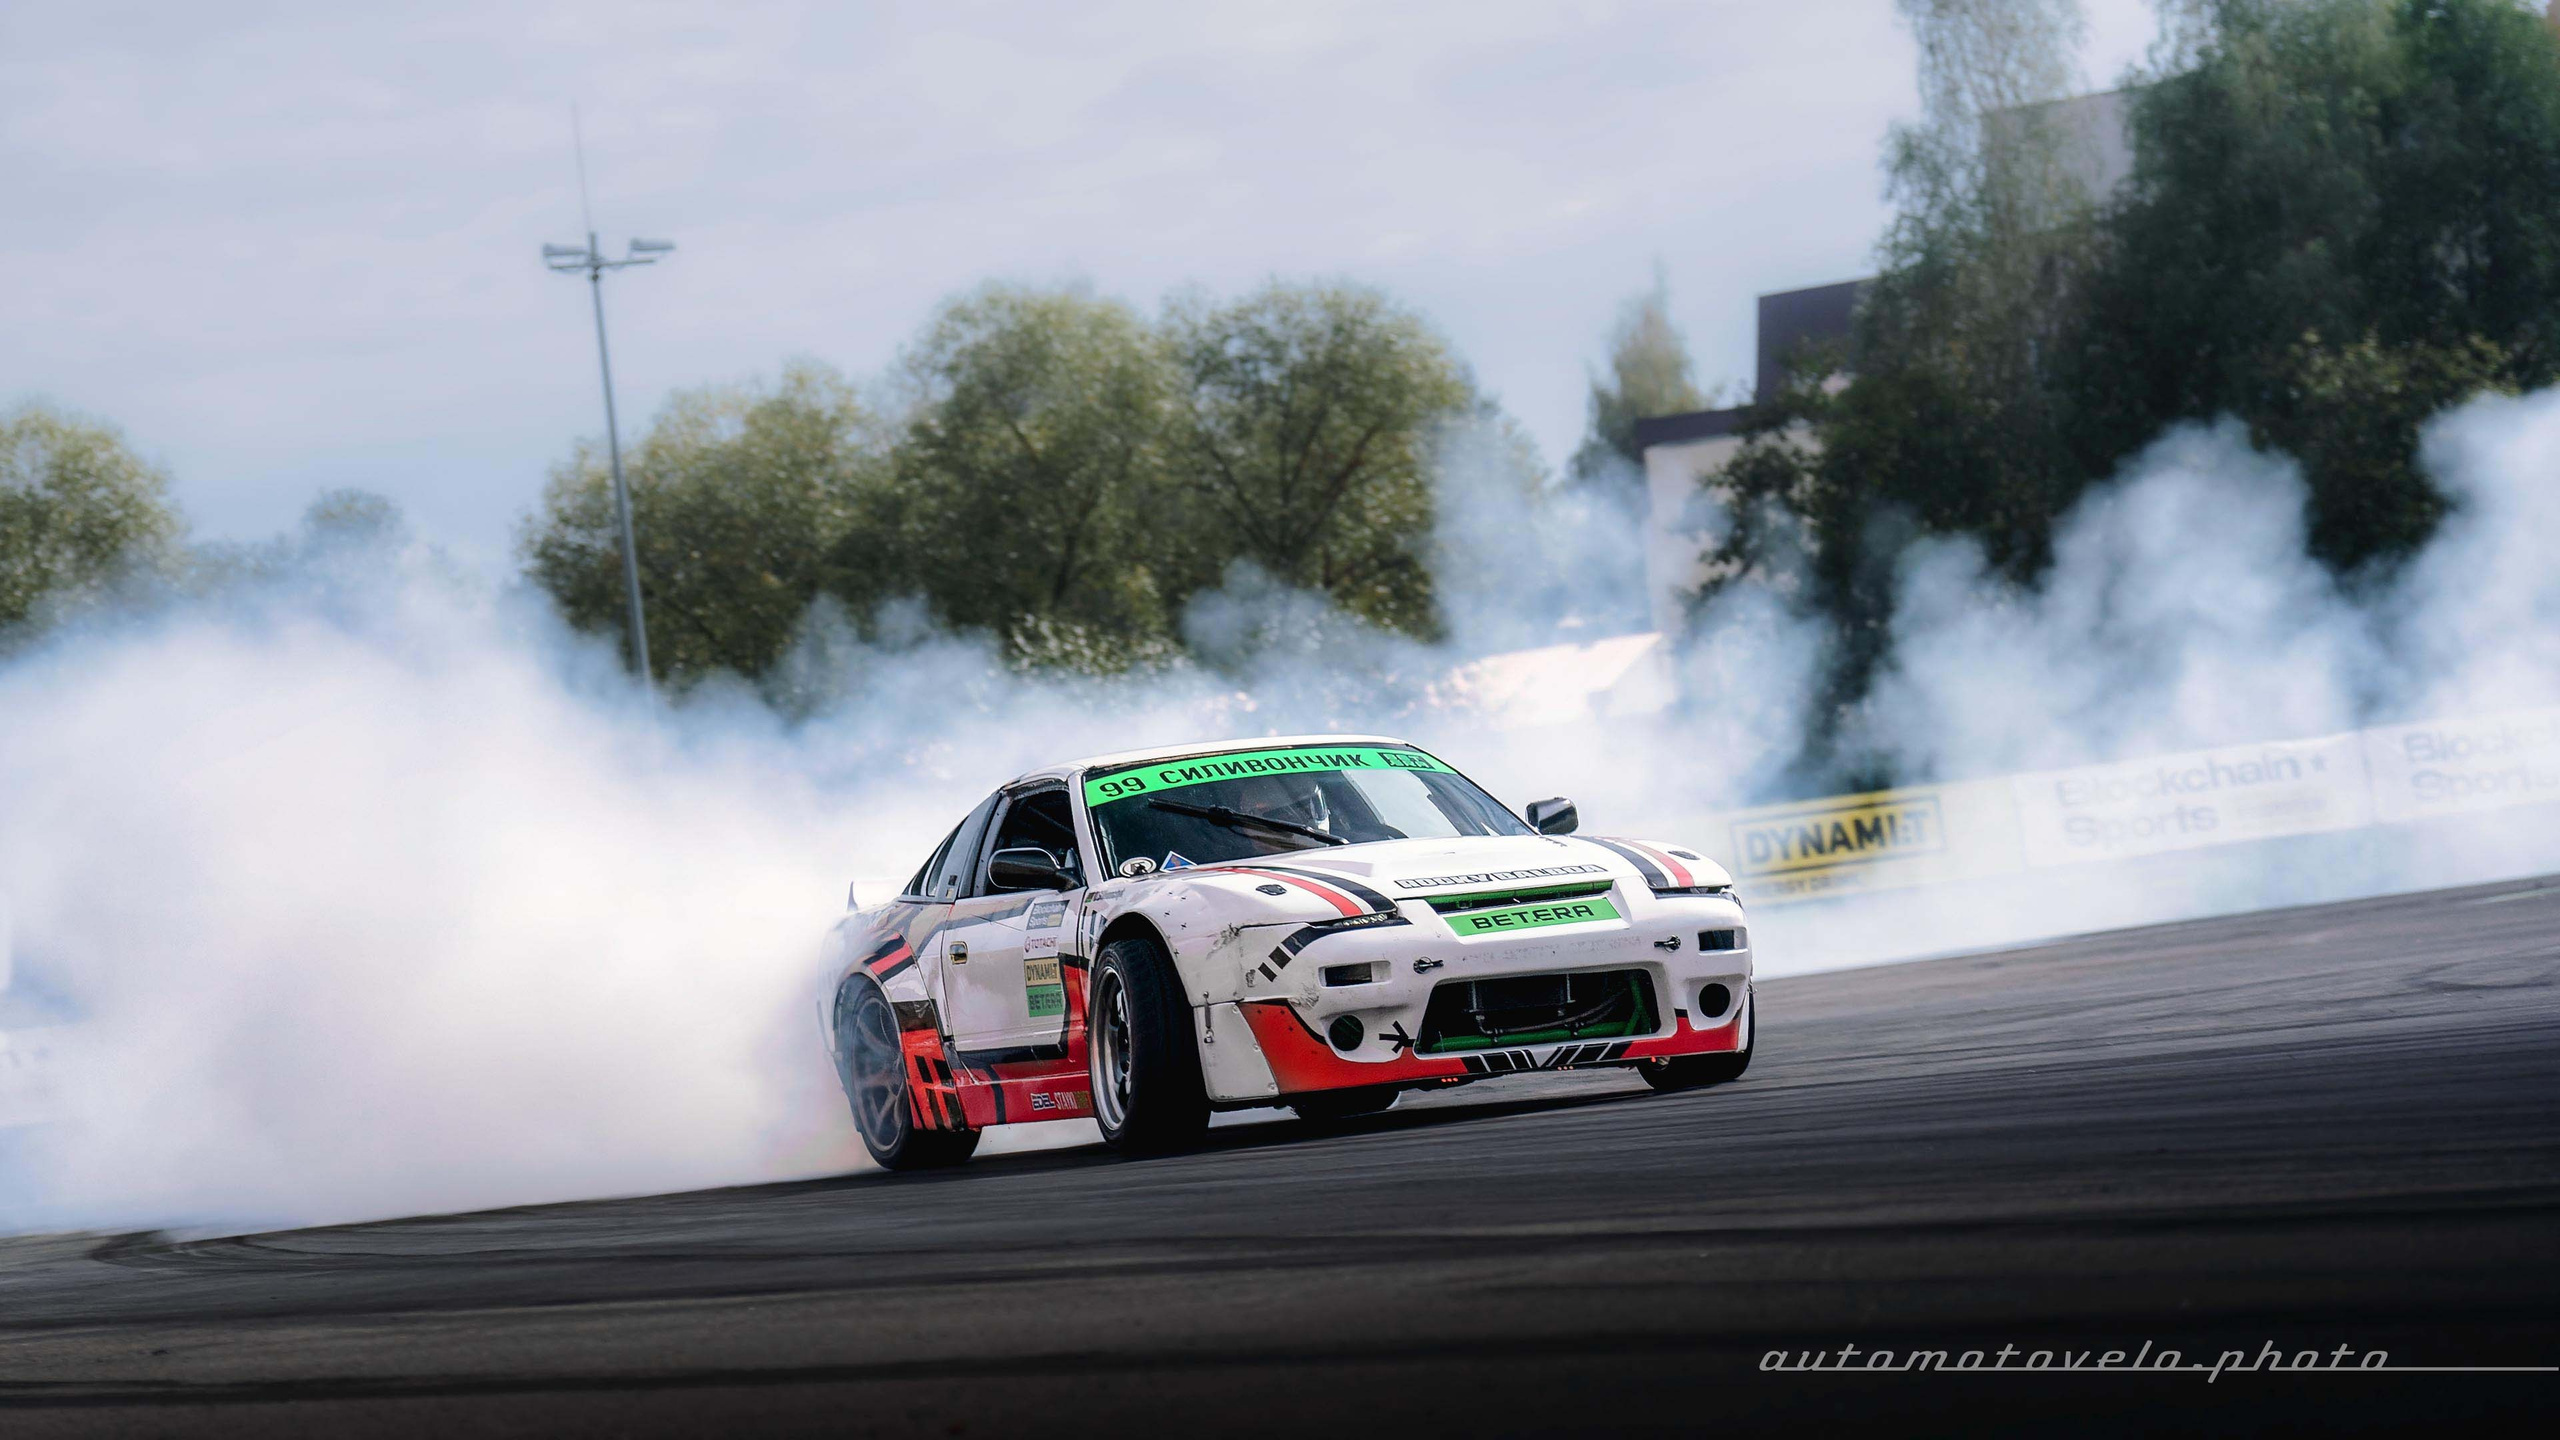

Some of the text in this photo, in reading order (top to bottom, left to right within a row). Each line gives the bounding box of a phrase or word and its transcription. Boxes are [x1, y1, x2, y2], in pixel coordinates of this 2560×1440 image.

[1100, 775, 1147, 798] 99
[1158, 753, 1369, 784] СИЛИВОНЧИК
[2055, 751, 2304, 808] Blockchain
[2065, 803, 2221, 850] Sports
